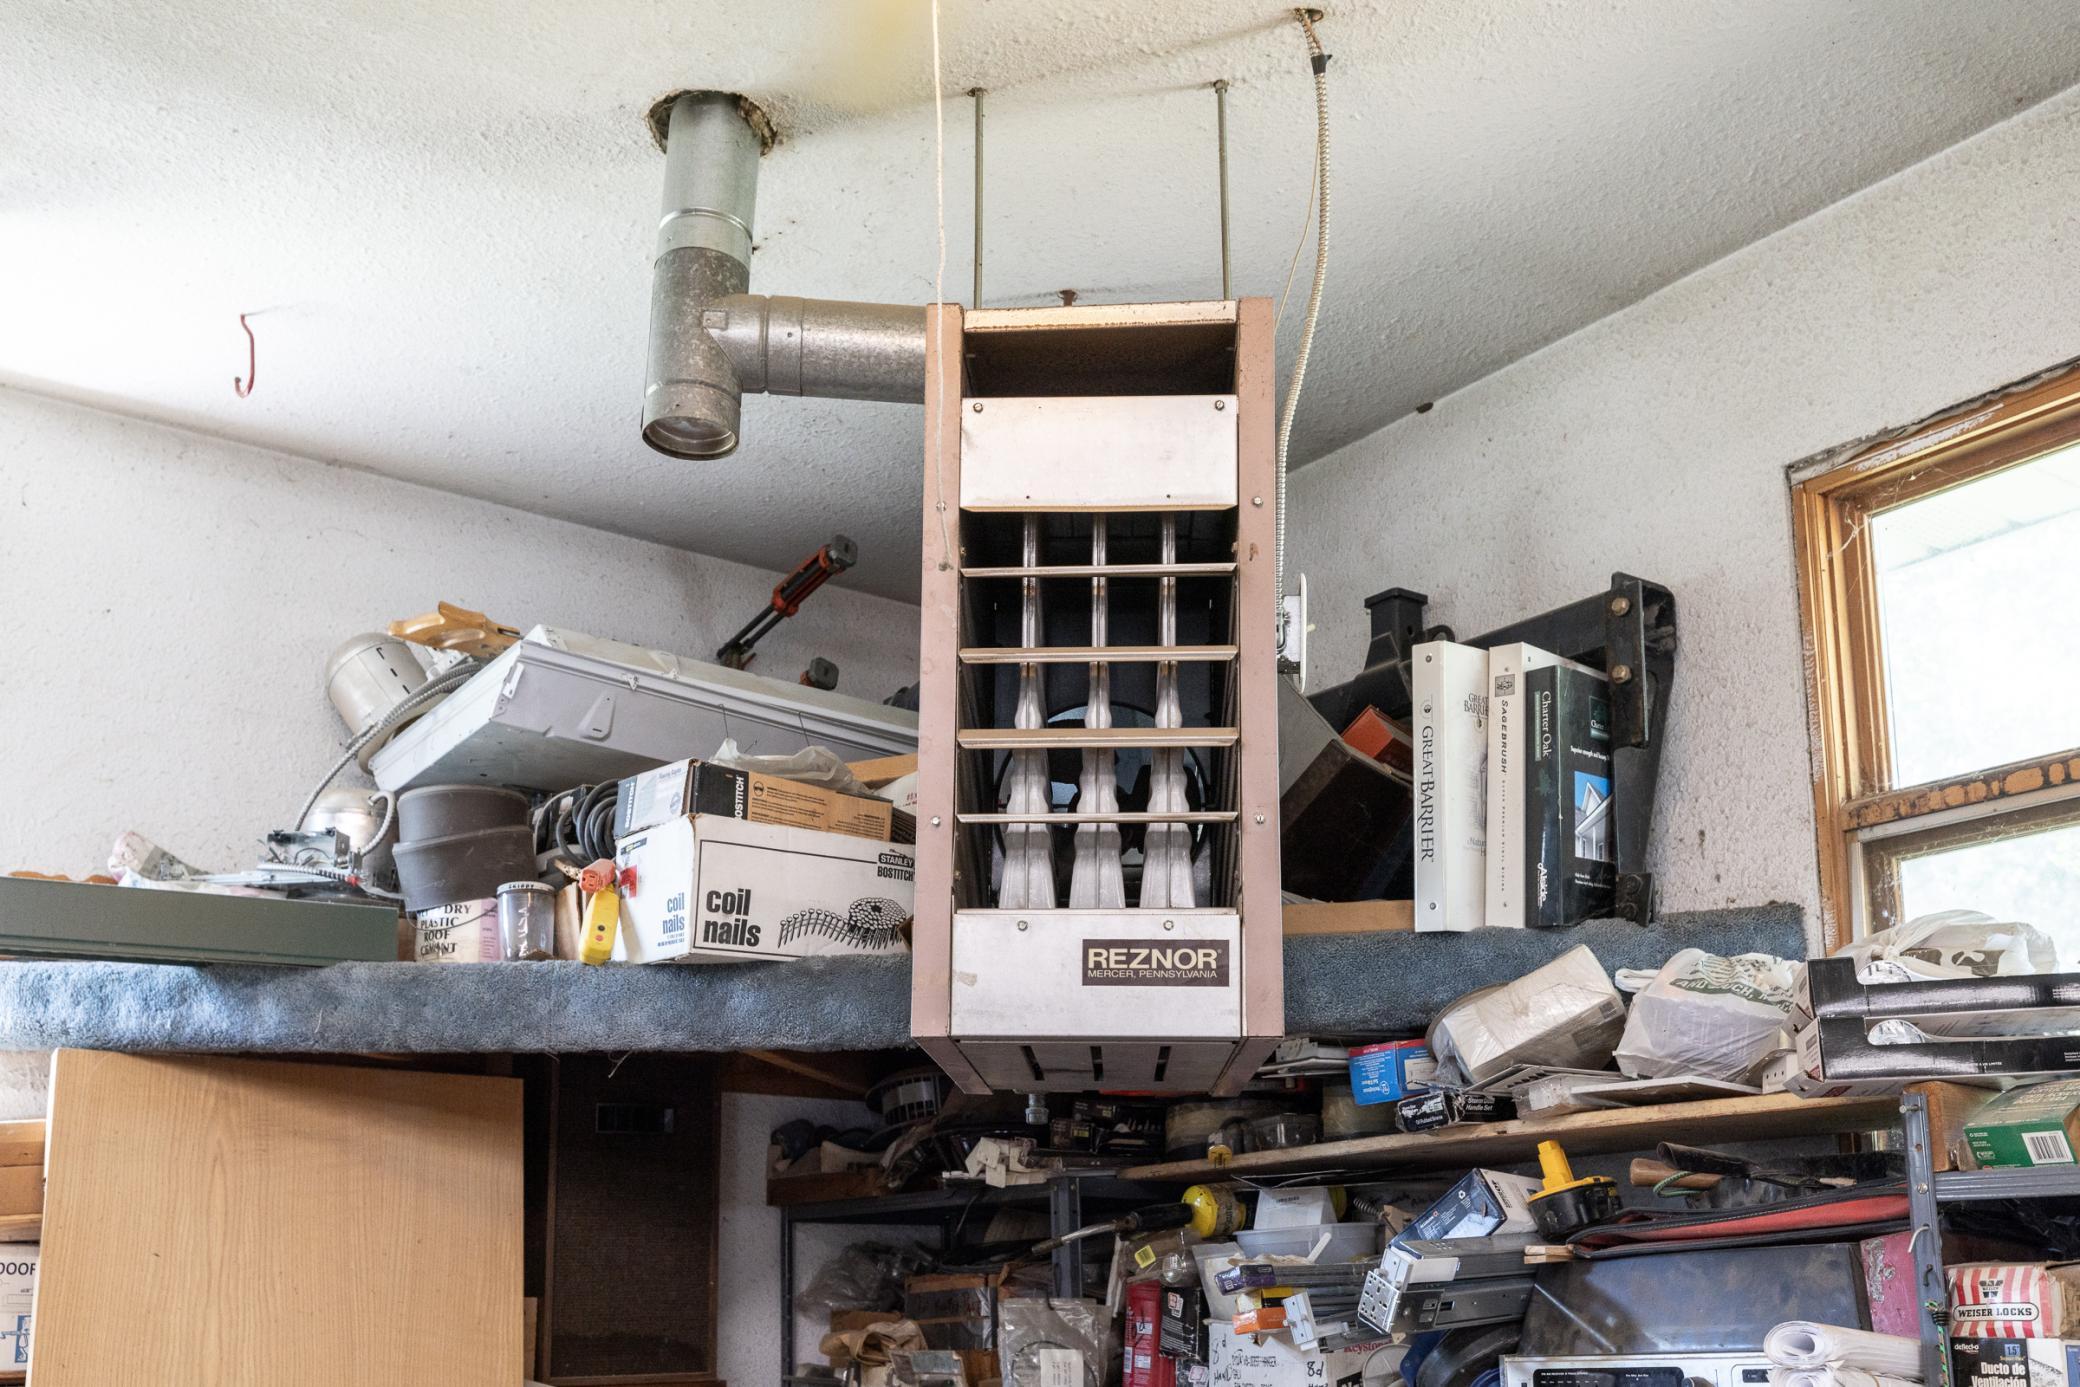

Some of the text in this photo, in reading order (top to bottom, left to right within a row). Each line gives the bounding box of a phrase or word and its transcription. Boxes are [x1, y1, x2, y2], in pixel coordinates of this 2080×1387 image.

[1542, 690, 1552, 758] Charter Oak
[1501, 699, 1509, 774] SAGEBRUSH
[734, 776, 745, 820] OSTITCH
[1417, 725, 1435, 862] GREAT BARRIER
[880, 854, 914, 868] STANLEY
[877, 866, 914, 881] BOSTITCH
[444, 902, 473, 915] DRY
[667, 892, 685, 913] coil
[706, 888, 752, 917] coil
[420, 916, 460, 930] PLASTIC
[662, 914, 685, 935] nails
[424, 929, 451, 942] ROOF
[703, 918, 761, 947] nails
[1087, 948, 1218, 969] REZNOR
[1088, 970, 1218, 979] MERCER, PENNSYLVANIA
[1958, 1307, 2032, 1318] WEISER LOCKS
[1307, 1360, 1324, 1378] 8d
[1980, 1362, 2026, 1375] Ducto de
[1970, 1375, 2027, 1387] Ventilación
